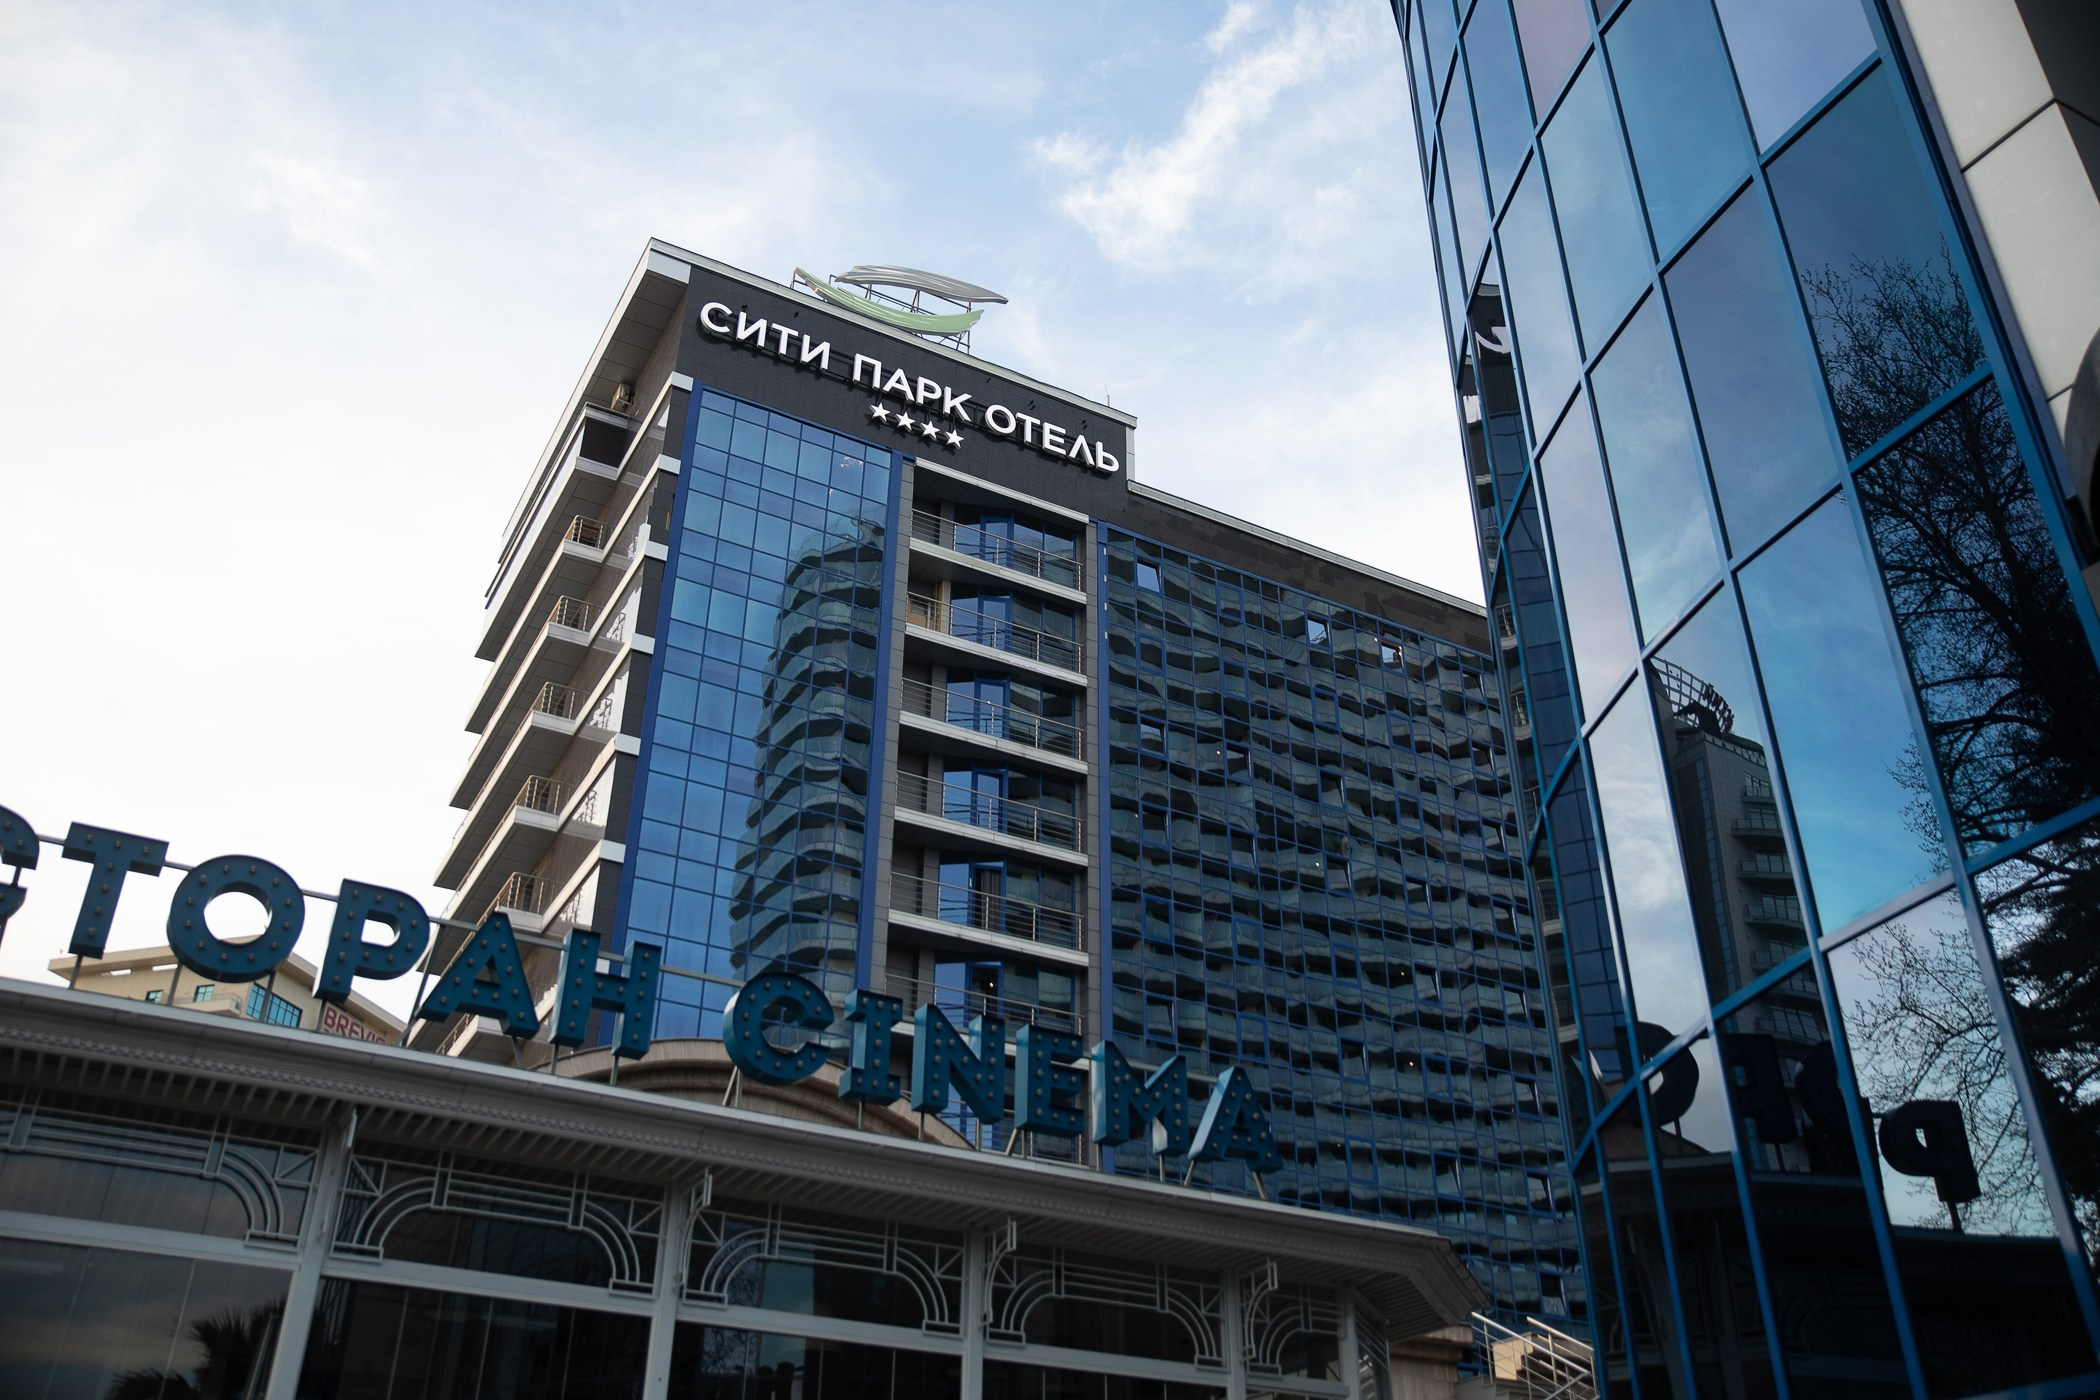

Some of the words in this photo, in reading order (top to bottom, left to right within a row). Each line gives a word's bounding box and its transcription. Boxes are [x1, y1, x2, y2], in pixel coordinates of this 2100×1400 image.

[700, 301, 831, 371] СИТИ
[853, 353, 973, 423] ПАРК
[985, 404, 1120, 474] ОТЕЛЬ
[324, 1006, 387, 1043] BREVI
[722, 972, 1284, 1174] CINEMA
